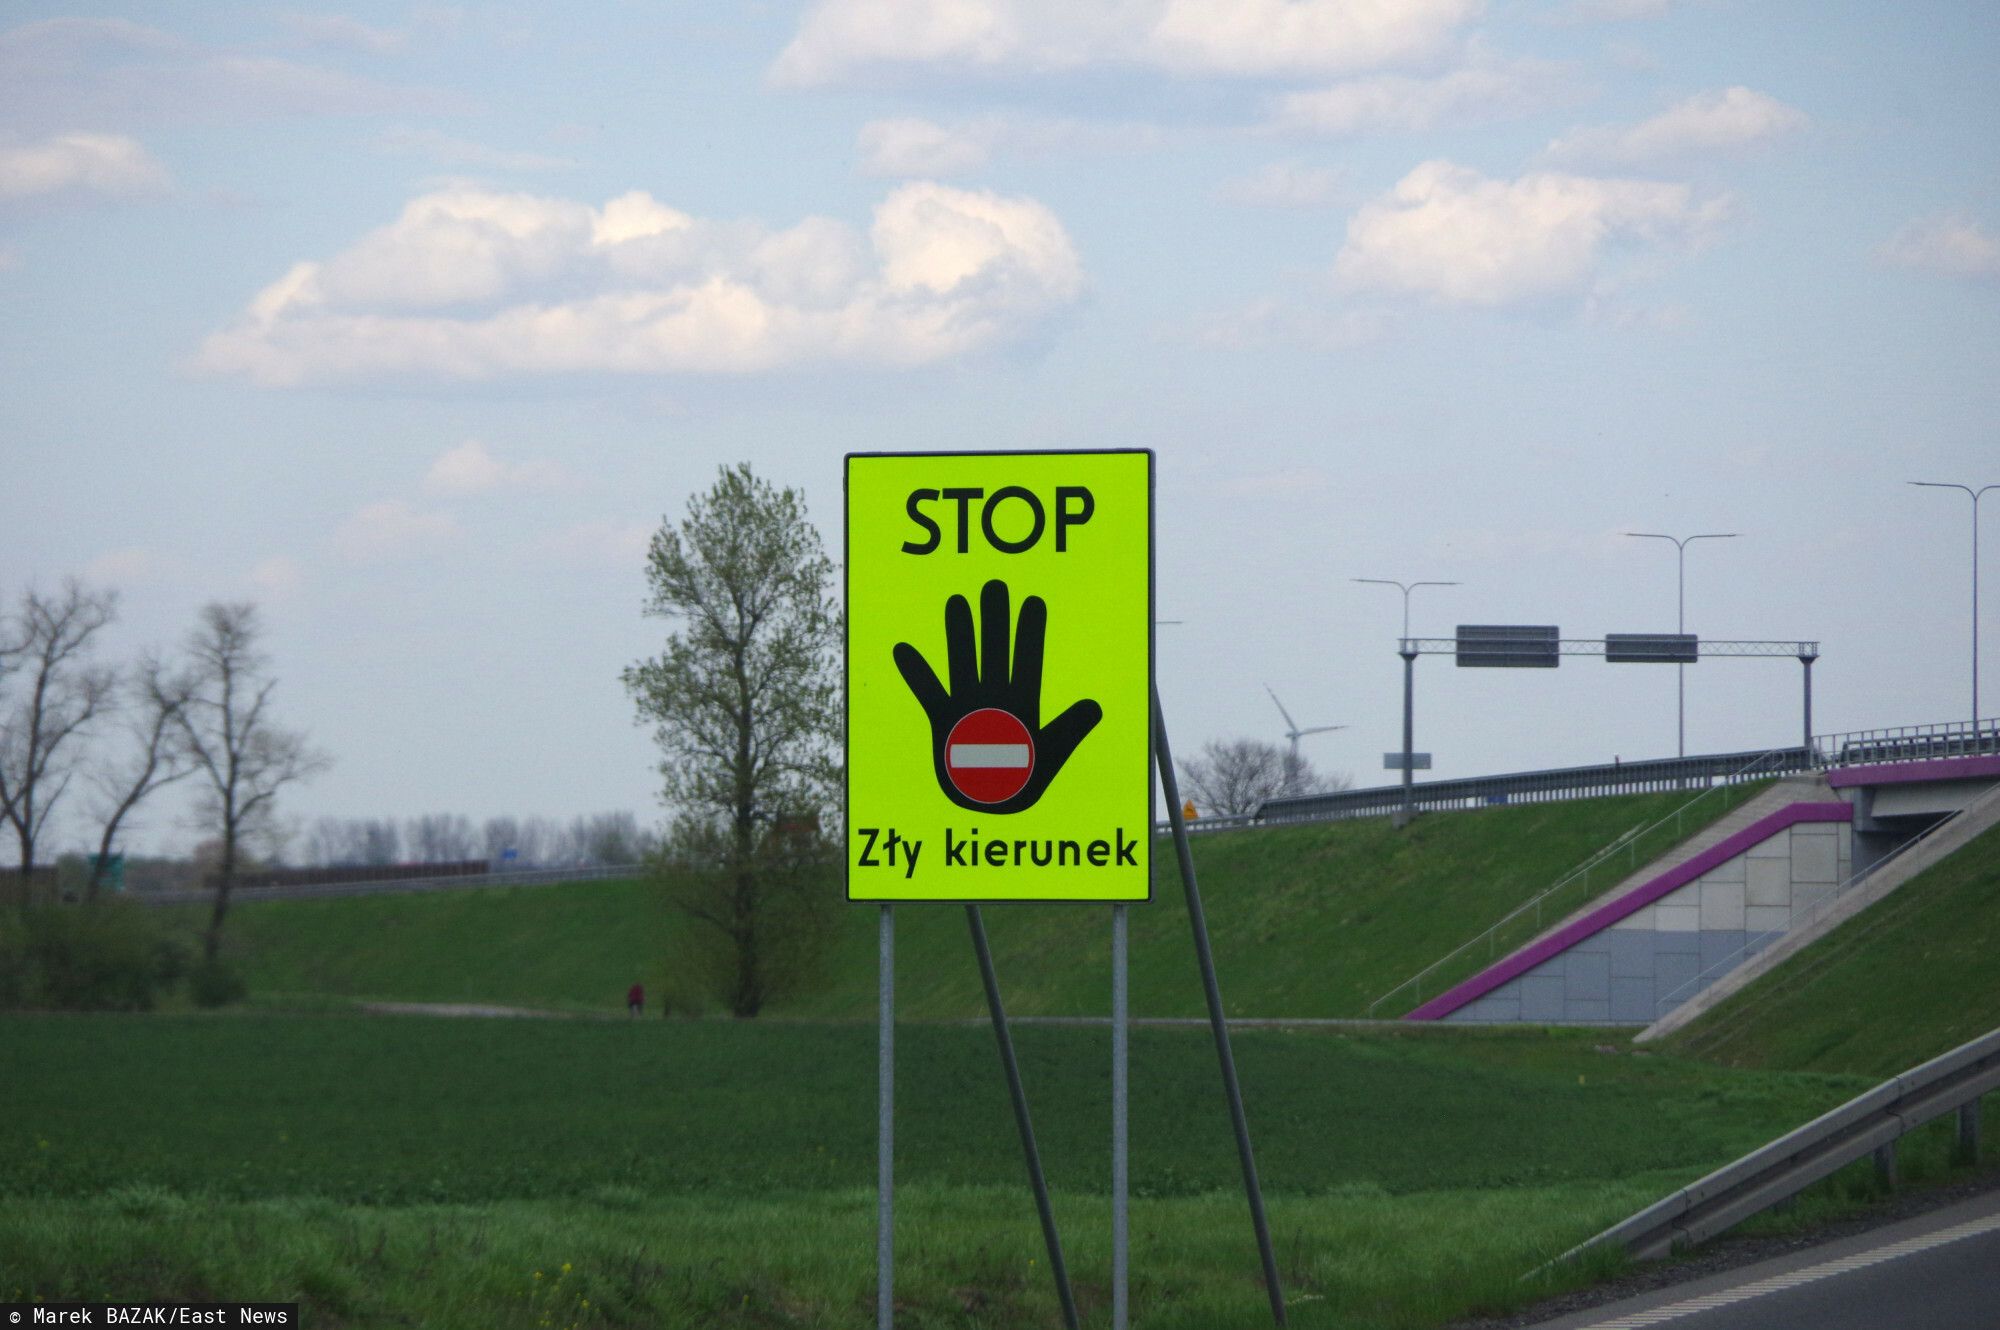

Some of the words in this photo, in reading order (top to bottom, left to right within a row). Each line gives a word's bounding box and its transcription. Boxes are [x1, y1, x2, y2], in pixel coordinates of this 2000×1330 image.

[901, 486, 1095, 555] STOP
[858, 828, 923, 879] Zły
[945, 827, 1138, 867] kierunek
